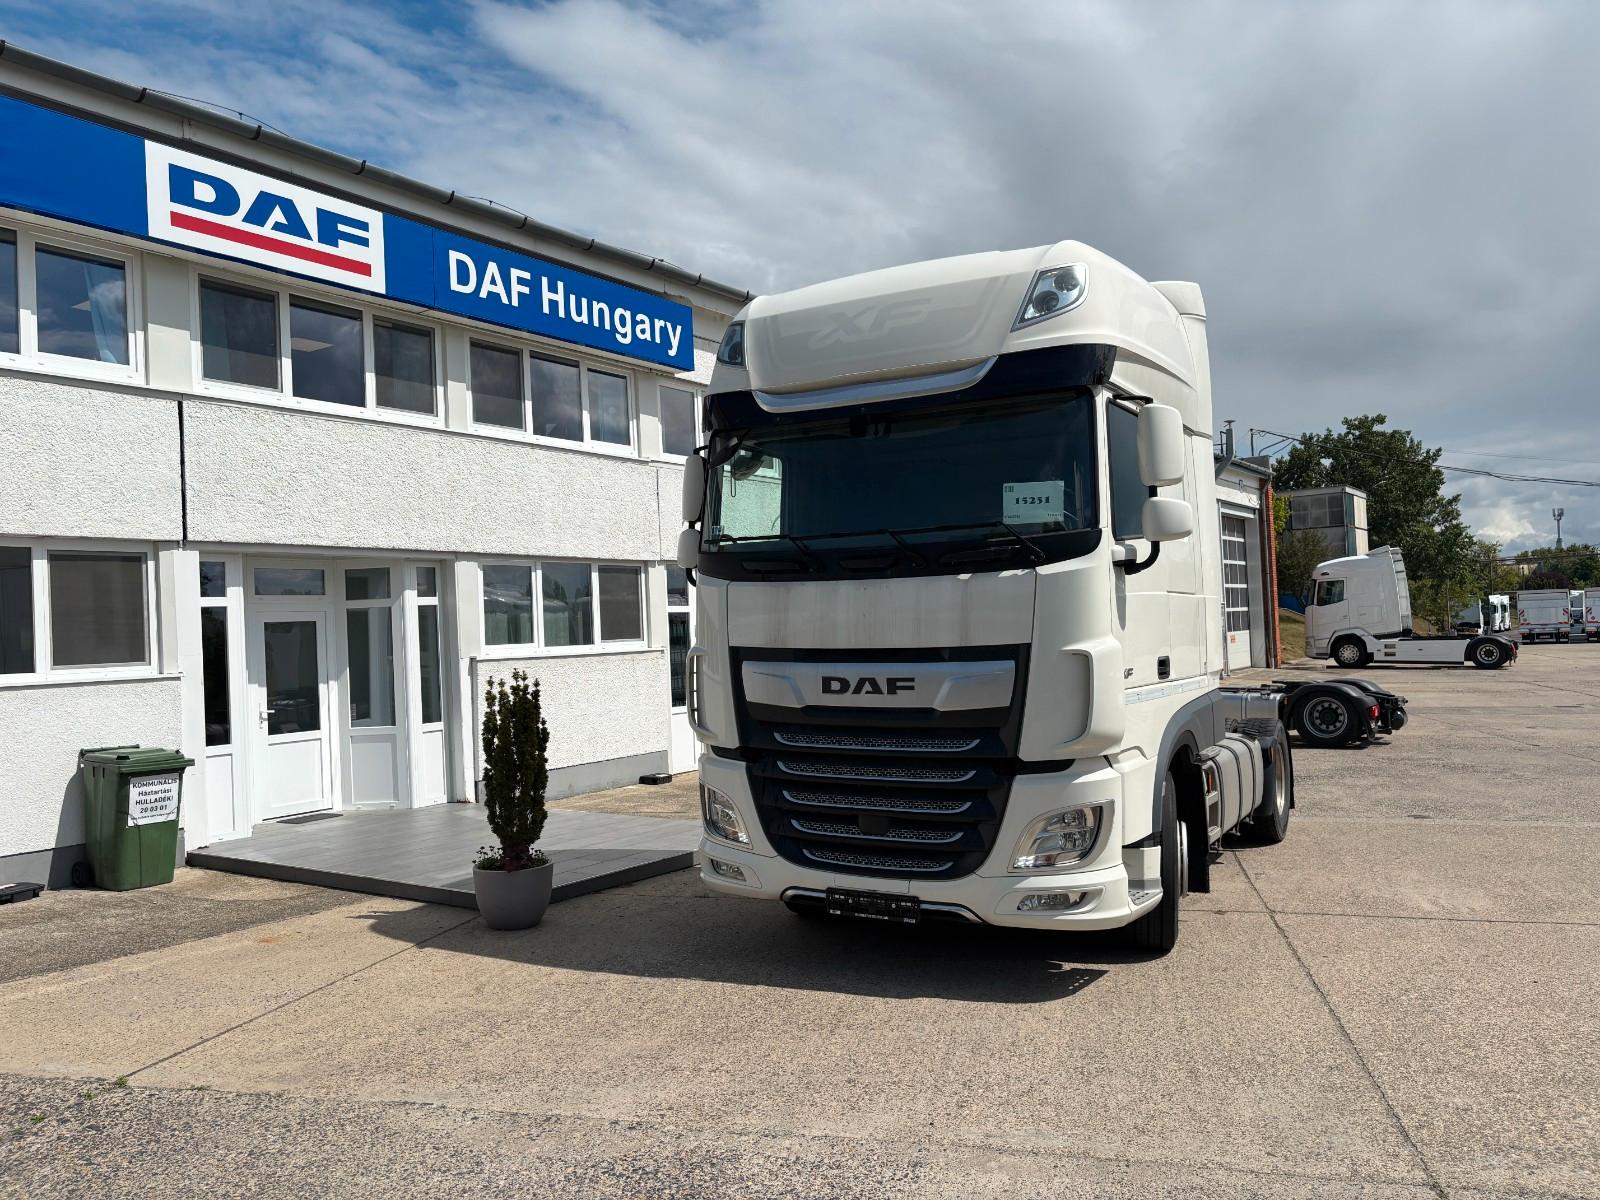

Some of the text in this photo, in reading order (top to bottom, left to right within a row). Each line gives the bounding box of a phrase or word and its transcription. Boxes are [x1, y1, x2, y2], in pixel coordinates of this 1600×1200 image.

[168, 163, 370, 249] DAF
[449, 249, 682, 356] DAF Hungary
[821, 676, 916, 695] DAF
[132, 778, 178, 788] KOMMUNÁLIS
[138, 788, 171, 796] Háztartási
